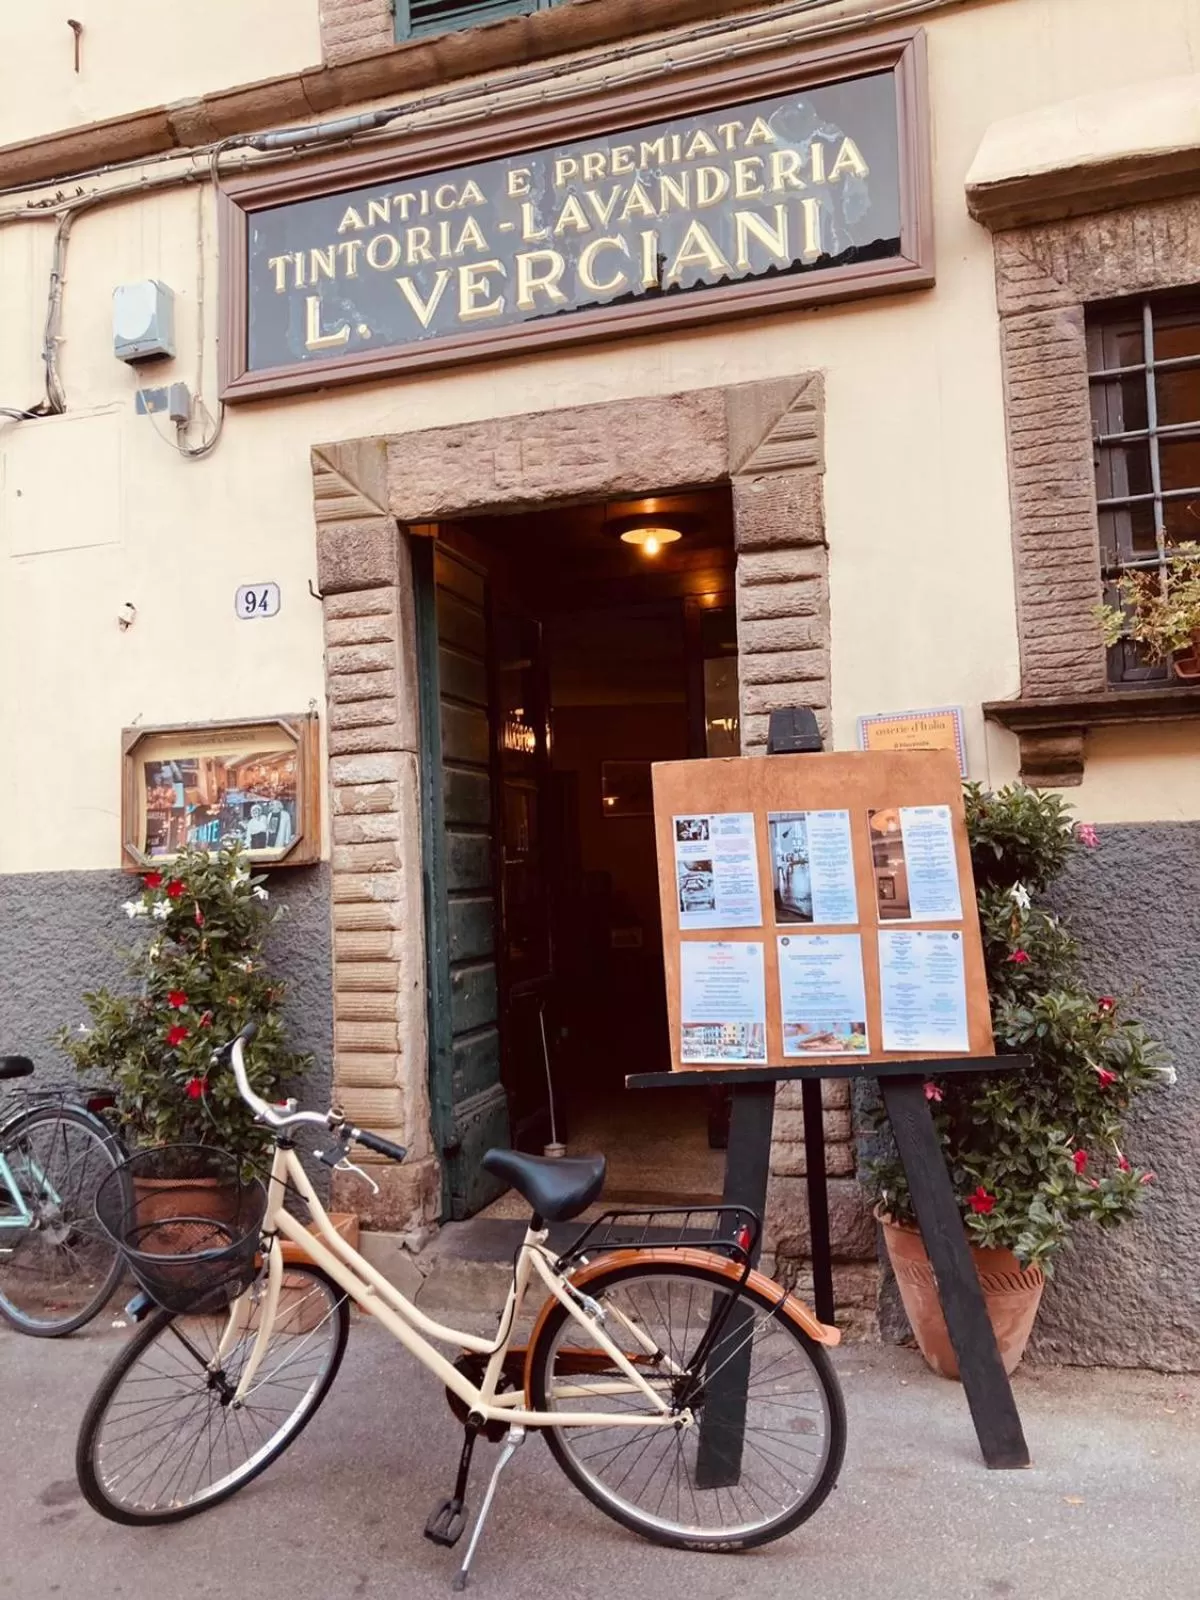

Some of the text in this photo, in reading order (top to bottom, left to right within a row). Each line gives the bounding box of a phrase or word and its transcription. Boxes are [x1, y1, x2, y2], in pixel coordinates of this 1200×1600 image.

[338, 116, 777, 235] ANTICA E PREMIATA
[268, 215, 490, 293] TINTORIA
[304, 197, 824, 351] L. VERCIANI
[245, 589, 268, 613] 94
